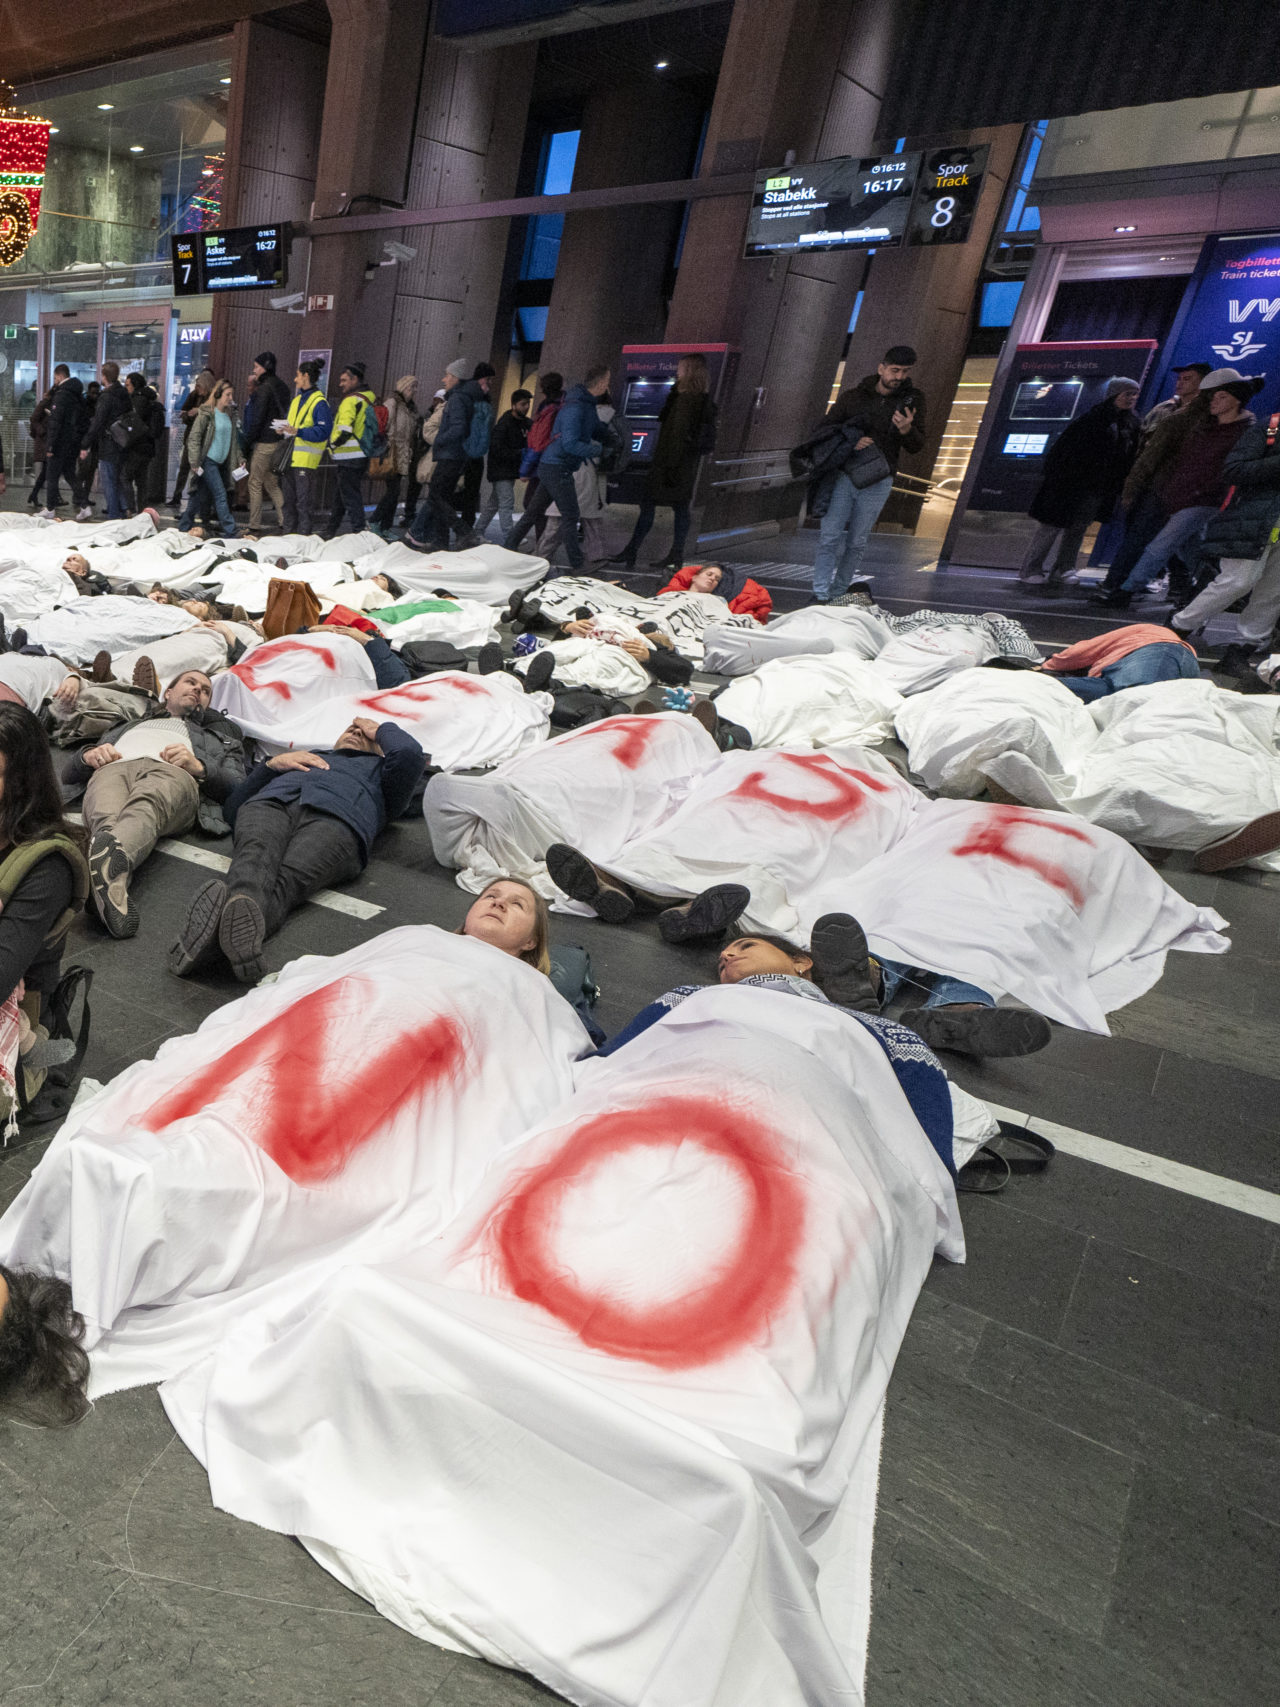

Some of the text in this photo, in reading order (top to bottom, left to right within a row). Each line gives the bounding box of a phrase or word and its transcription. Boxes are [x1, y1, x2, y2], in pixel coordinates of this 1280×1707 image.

[881, 162, 907, 173] 16:12
[937, 164, 968, 177] Spor
[863, 178, 904, 194] 16:17
[936, 174, 969, 188] Track
[764, 187, 817, 204] Stabekk
[930, 196, 955, 227] 8
[177, 243, 191, 252] Spor
[206, 246, 226, 256] Asker
[256, 240, 276, 251] 16:27
[178, 250, 193, 259] Track
[181, 264, 191, 285] 7
[1221, 270, 1247, 280] Train
[1231, 331, 1253, 346] SJ
[1064, 361, 1098, 370] Tickets
